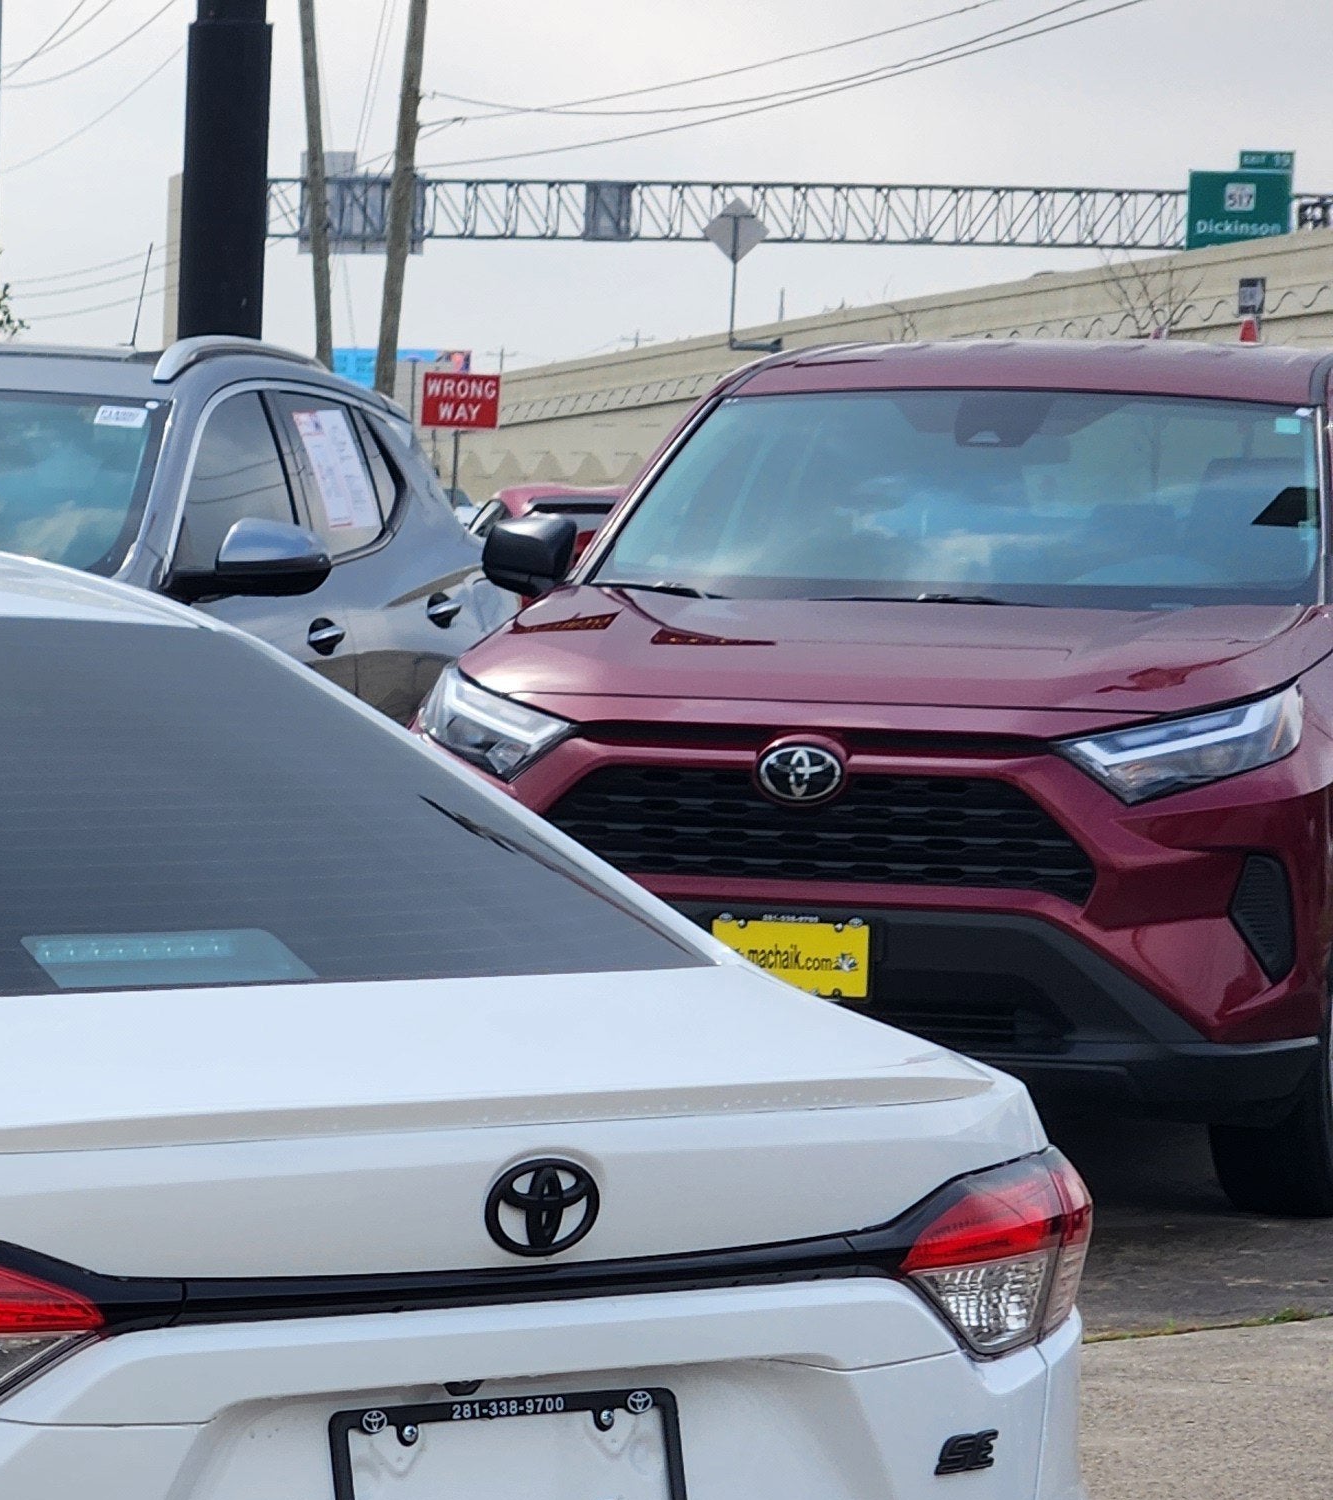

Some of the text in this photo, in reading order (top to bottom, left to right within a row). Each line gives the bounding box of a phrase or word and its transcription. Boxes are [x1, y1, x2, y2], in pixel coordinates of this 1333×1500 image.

[1228, 191, 1253, 207] 517
[1195, 218, 1282, 235] Dickinson
[426, 377, 497, 400] WRONG
[438, 402, 481, 421] WAY
[452, 1396, 564, 1420] 281-338-9700
[934, 1428, 999, 1476] SE
